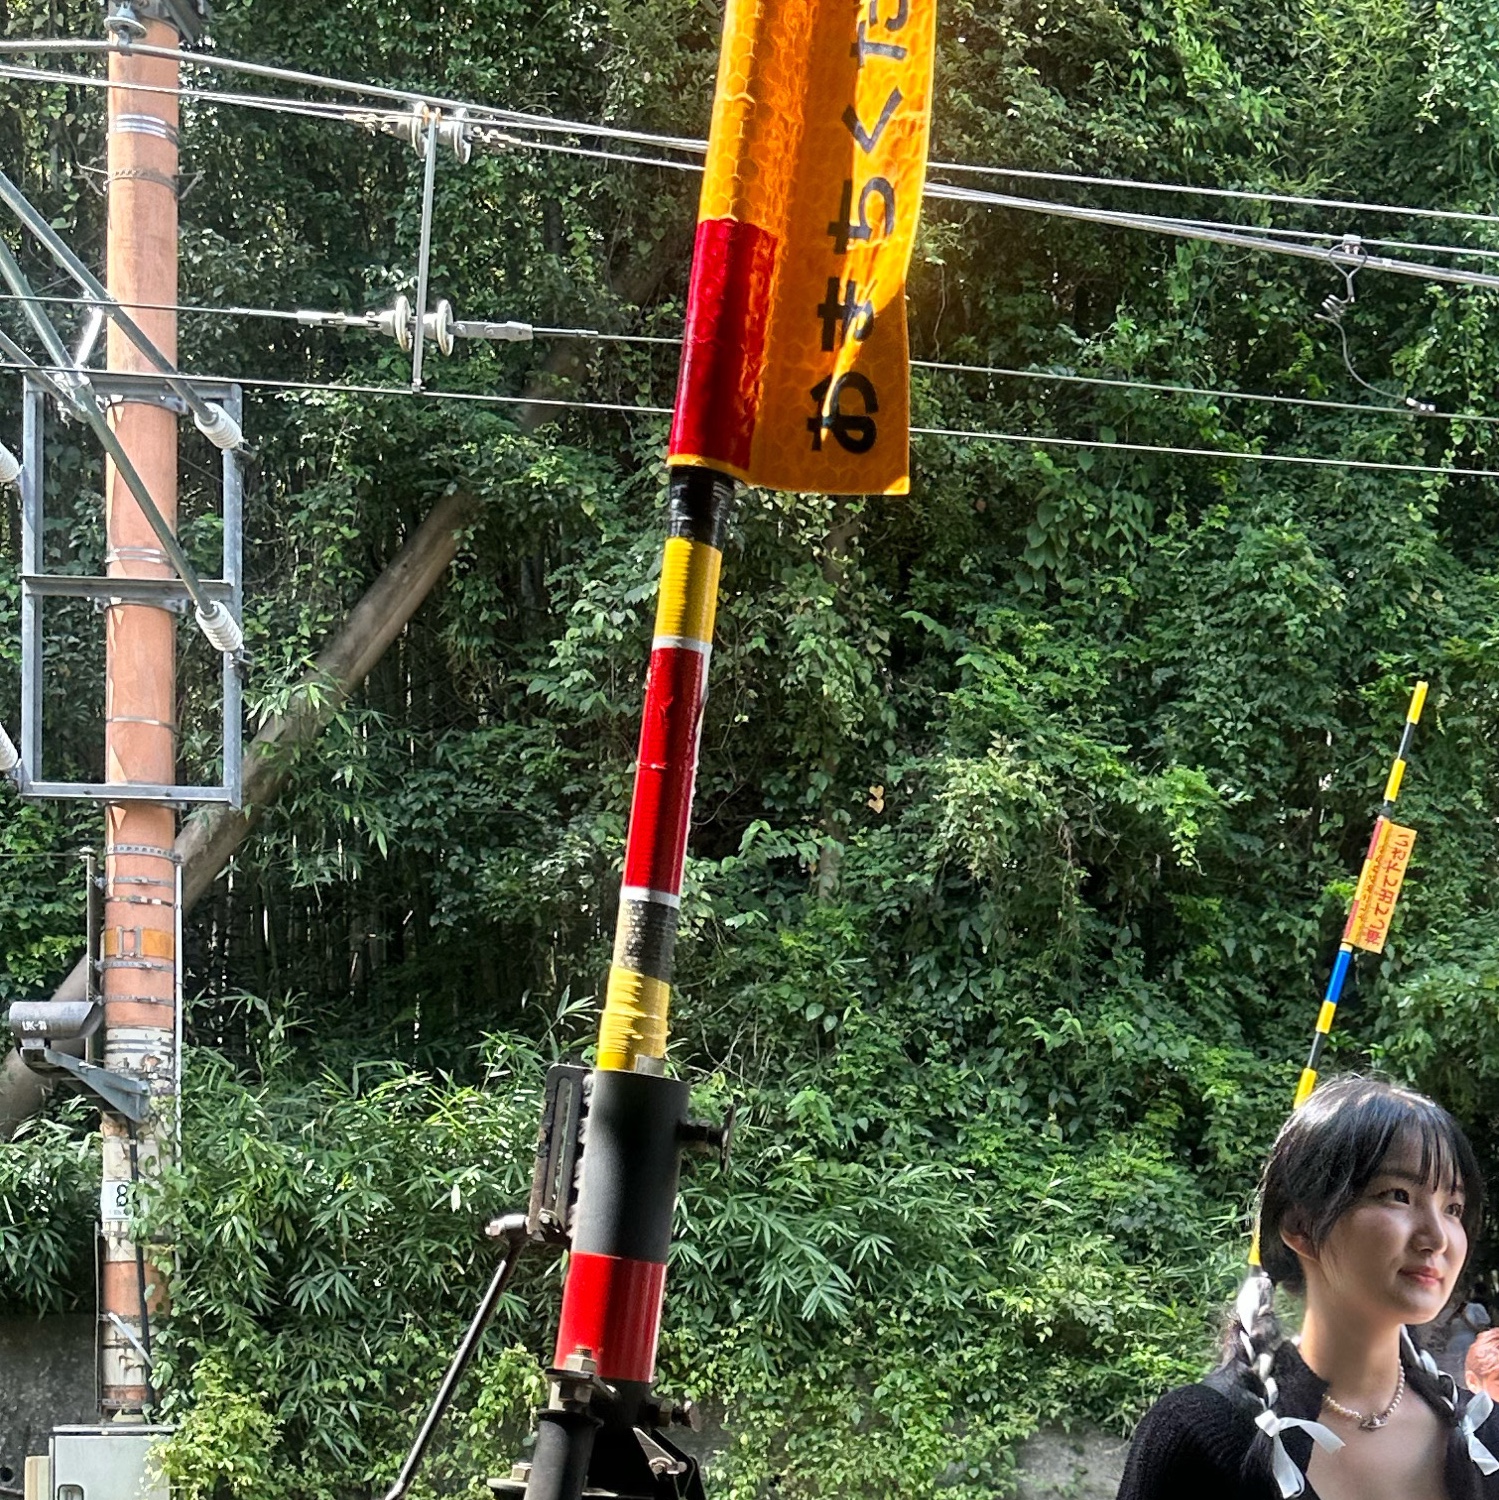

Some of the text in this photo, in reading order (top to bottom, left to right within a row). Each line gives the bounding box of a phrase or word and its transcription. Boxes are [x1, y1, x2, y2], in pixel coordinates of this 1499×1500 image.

[1365, 834, 1411, 946] 押して出て下さい
